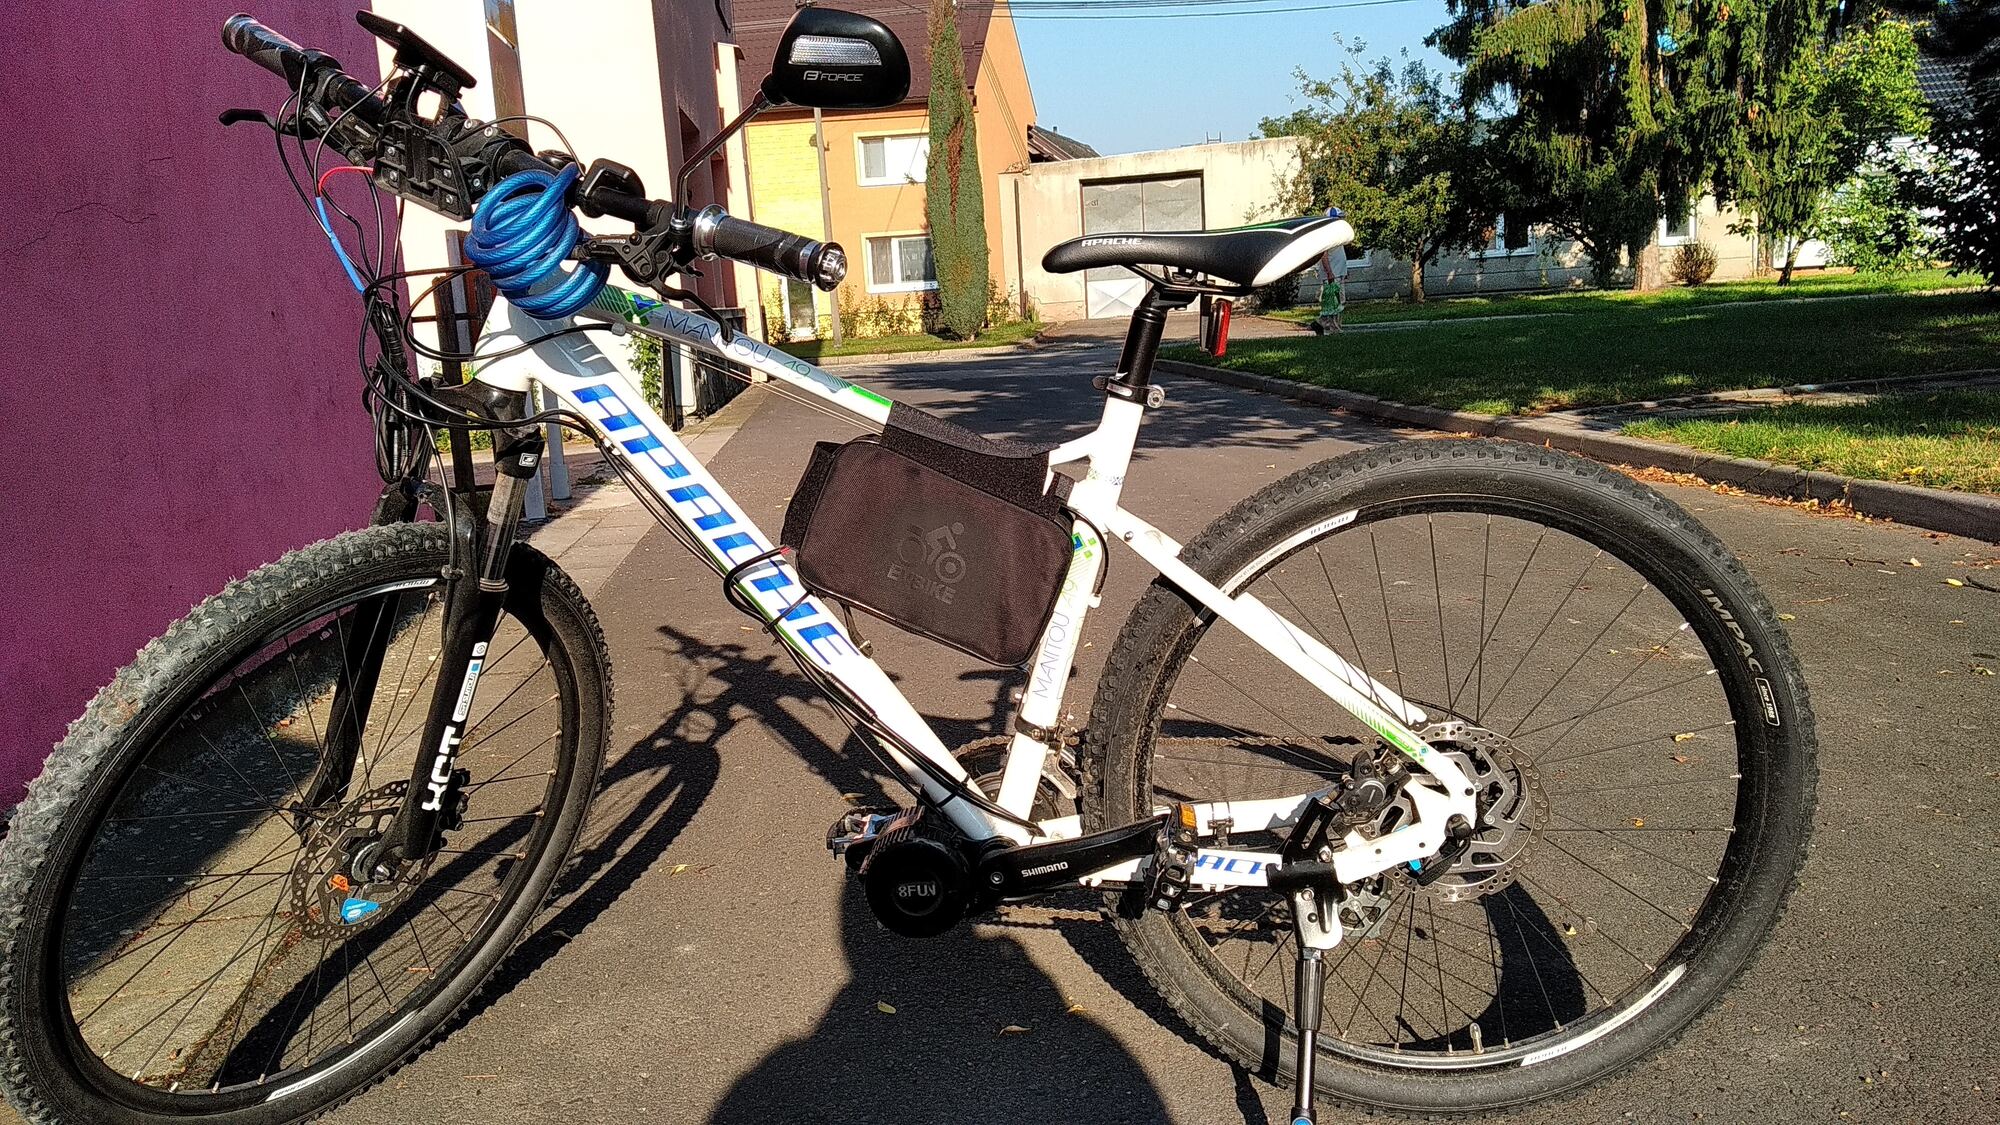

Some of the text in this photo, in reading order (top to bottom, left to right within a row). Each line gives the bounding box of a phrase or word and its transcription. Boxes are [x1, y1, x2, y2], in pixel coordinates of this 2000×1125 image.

[820, 73, 863, 81] FORCE
[1081, 237, 1142, 247] APACHE
[571, 384, 860, 665] APACHE
[1700, 588, 1763, 673] IMPAC
[1032, 611, 1070, 698] MANITOU
[1760, 685, 1770, 701] since
[1021, 861, 1069, 878] SHIMANO
